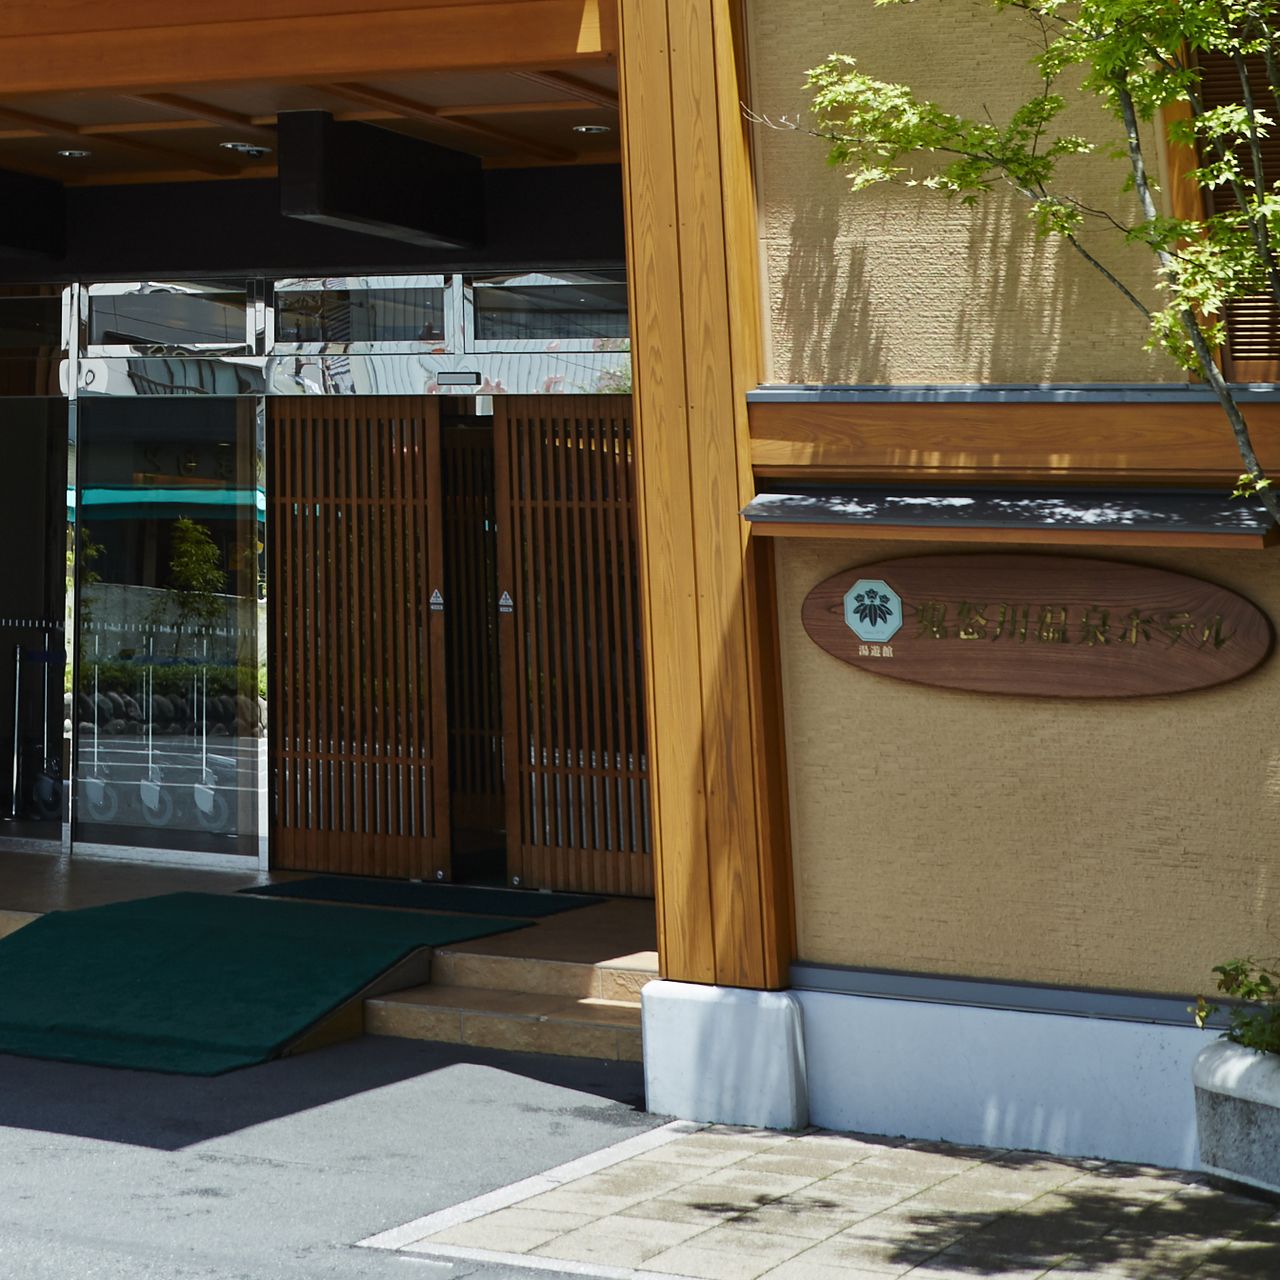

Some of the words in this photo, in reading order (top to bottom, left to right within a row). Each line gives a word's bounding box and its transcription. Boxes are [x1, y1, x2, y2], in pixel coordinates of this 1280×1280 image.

[915, 600, 1235, 649] 鬼怒川温泉ホテル
